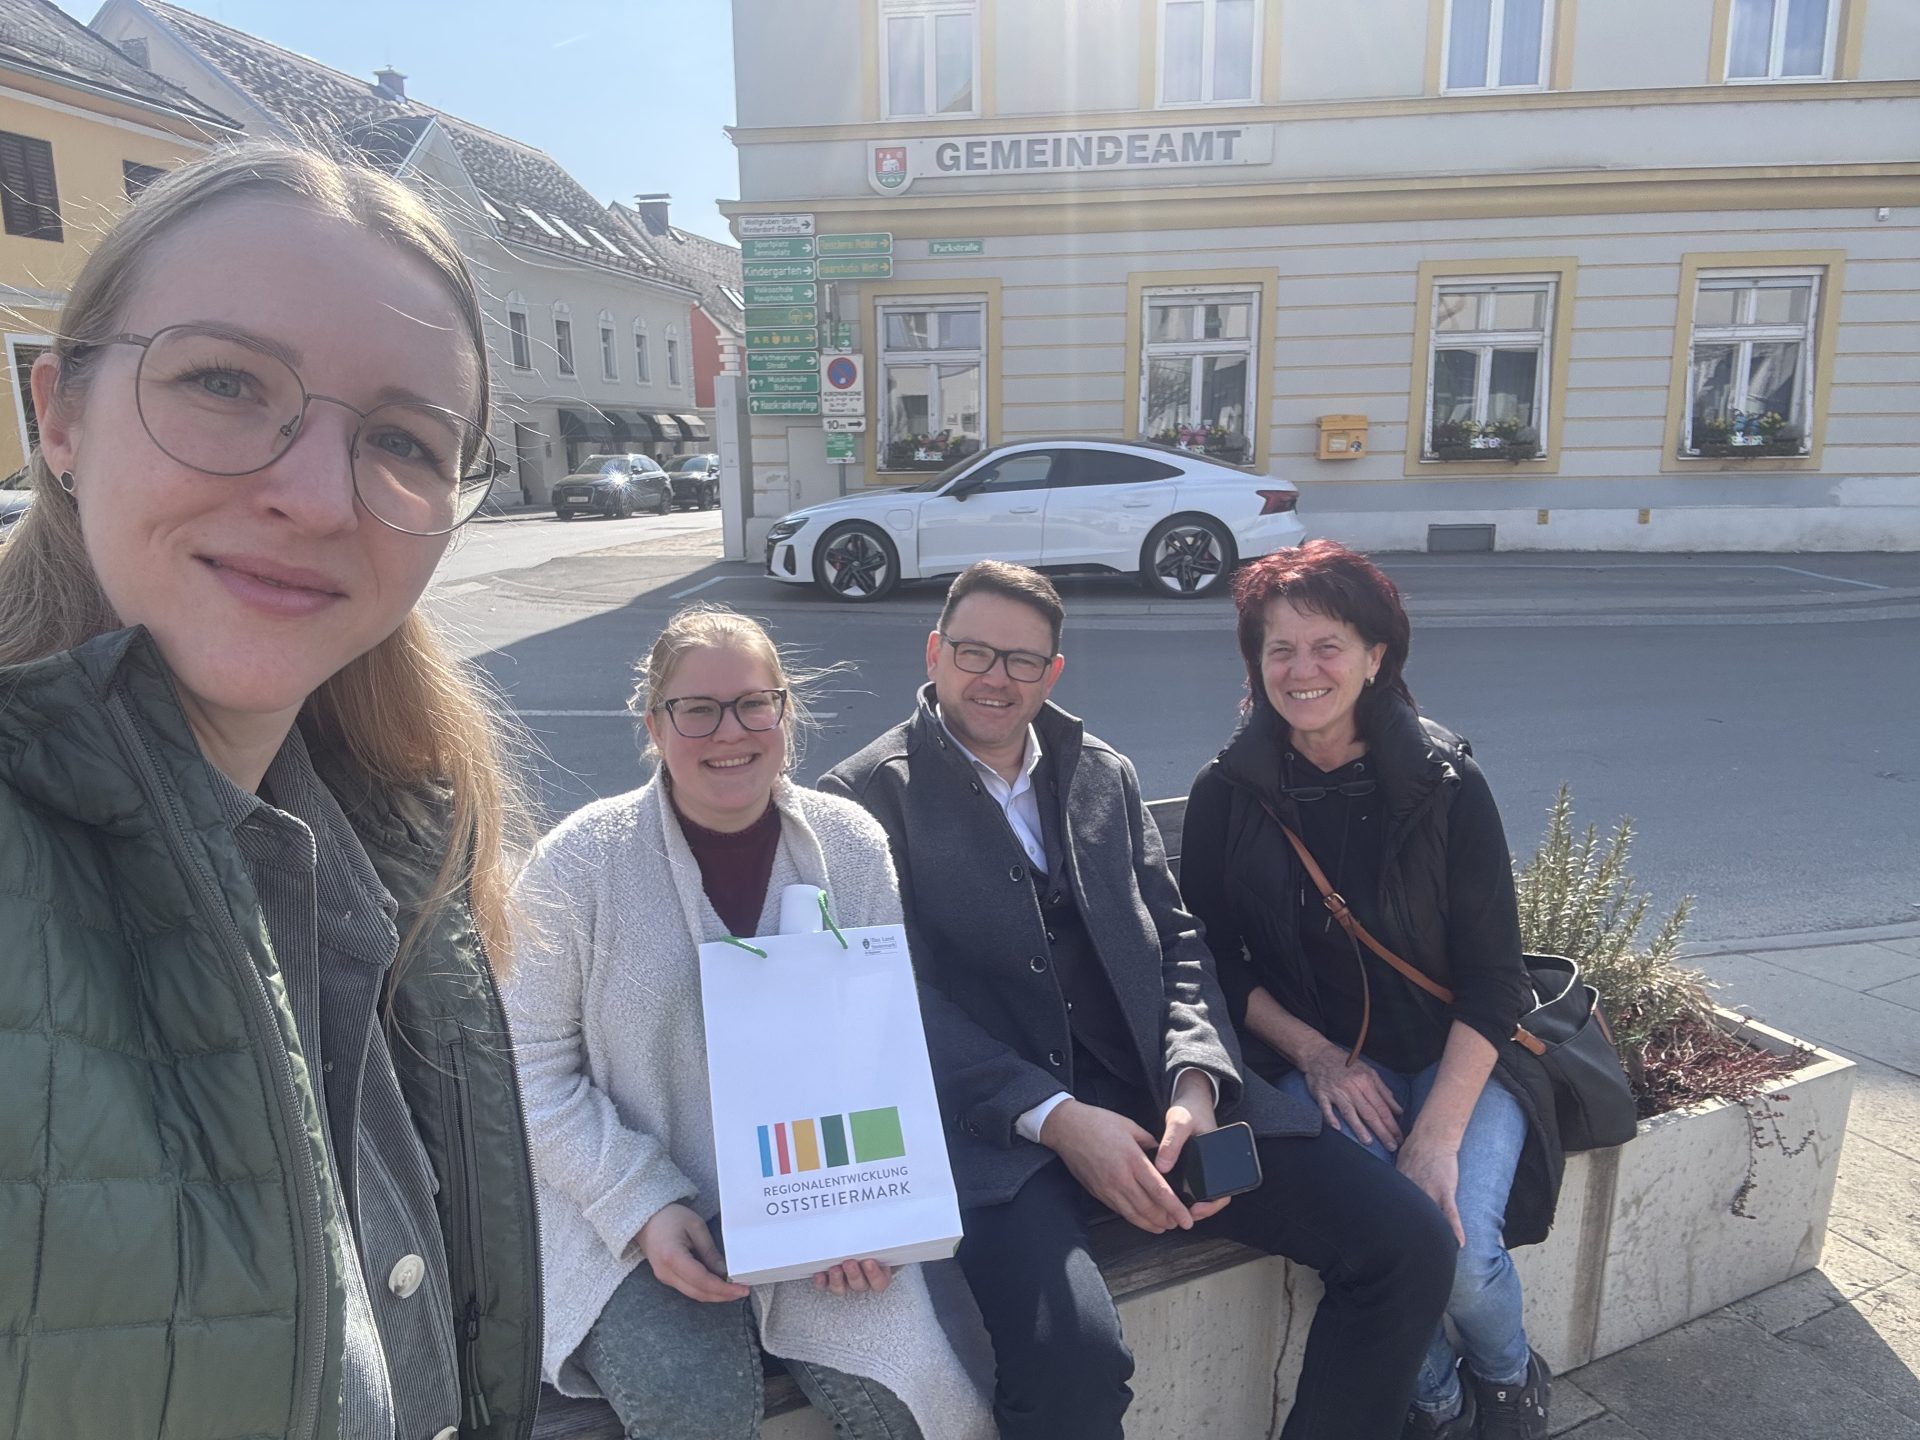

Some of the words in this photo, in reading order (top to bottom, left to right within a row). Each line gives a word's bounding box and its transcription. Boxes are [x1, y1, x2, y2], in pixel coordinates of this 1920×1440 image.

[935, 130, 1242, 172] GEMEINDEAMT
[754, 241, 790, 249] Sportplatz
[933, 243, 979, 252] Parkstraße
[754, 249, 791, 257] Tennisplatz
[744, 265, 802, 279] Kindergarten
[754, 286, 794, 294] Volksschule
[753, 294, 794, 303] Hauptschule
[767, 376, 808, 384] Musikschule
[763, 1166, 909, 1197] REGIONALENTWICKLUNG
[766, 1181, 911, 1216] OSTSTEIERMARK
